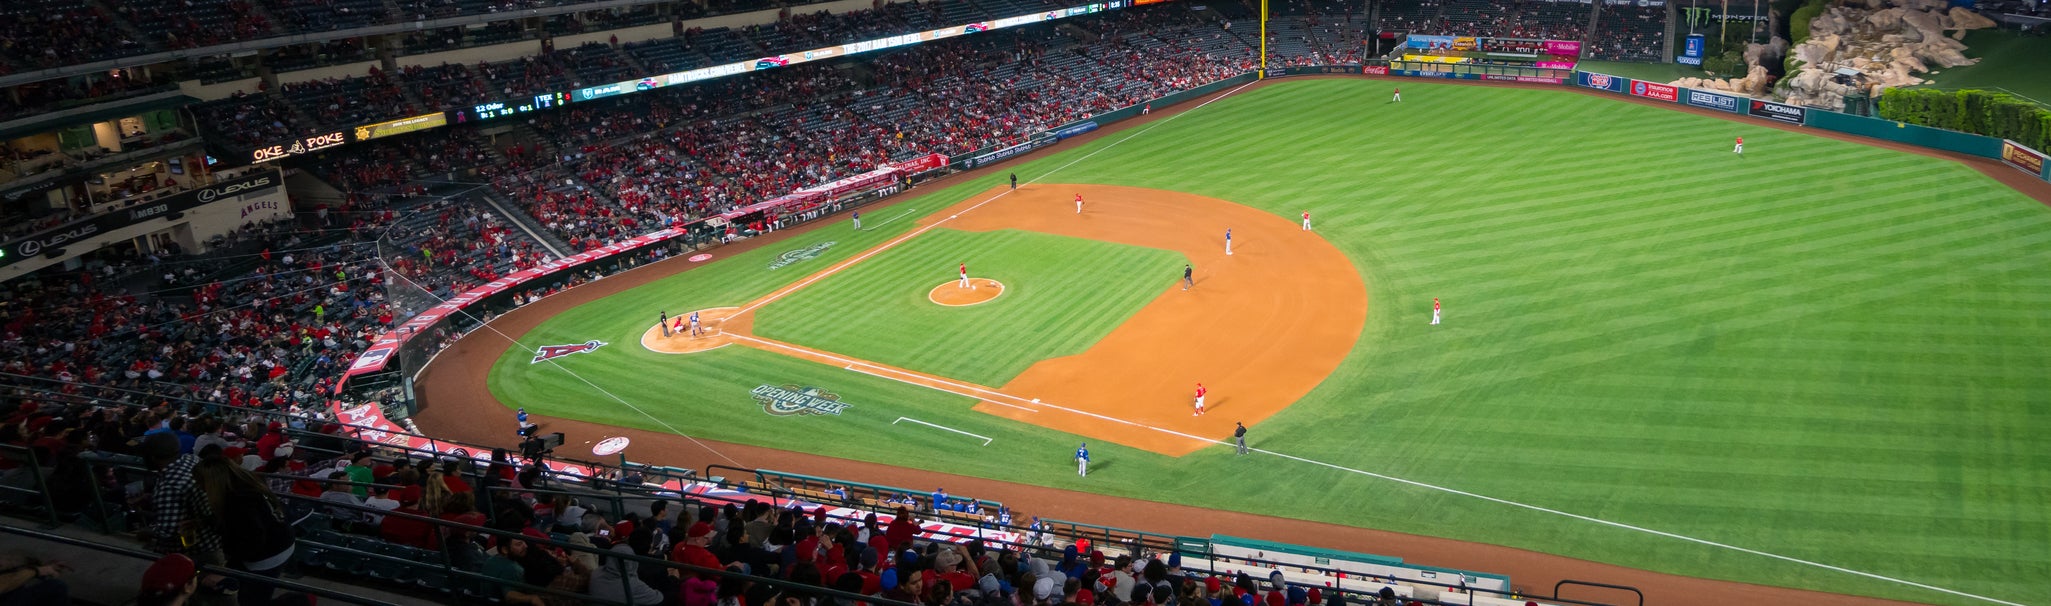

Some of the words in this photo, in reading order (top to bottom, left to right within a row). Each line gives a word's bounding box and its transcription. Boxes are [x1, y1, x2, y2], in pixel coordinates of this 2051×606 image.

[595, 86, 620, 95] RAM
[1648, 84, 1673, 93] Insurance
[1648, 91, 1672, 99] AAA.com
[539, 94, 553, 102] TEX
[1764, 103, 1801, 116] YOKOHAMA
[254, 145, 284, 160] OKE
[306, 132, 344, 149] POKE
[976, 155, 995, 165] StubHub
[996, 149, 1013, 159] StubHub
[1014, 144, 1031, 153] StubHub
[216, 176, 271, 195] LEXUS
[241, 201, 278, 219] ANGELS
[41, 223, 97, 247] LEXUS
[751, 384, 810, 404] OPENING
[806, 397, 849, 415] WEEK
